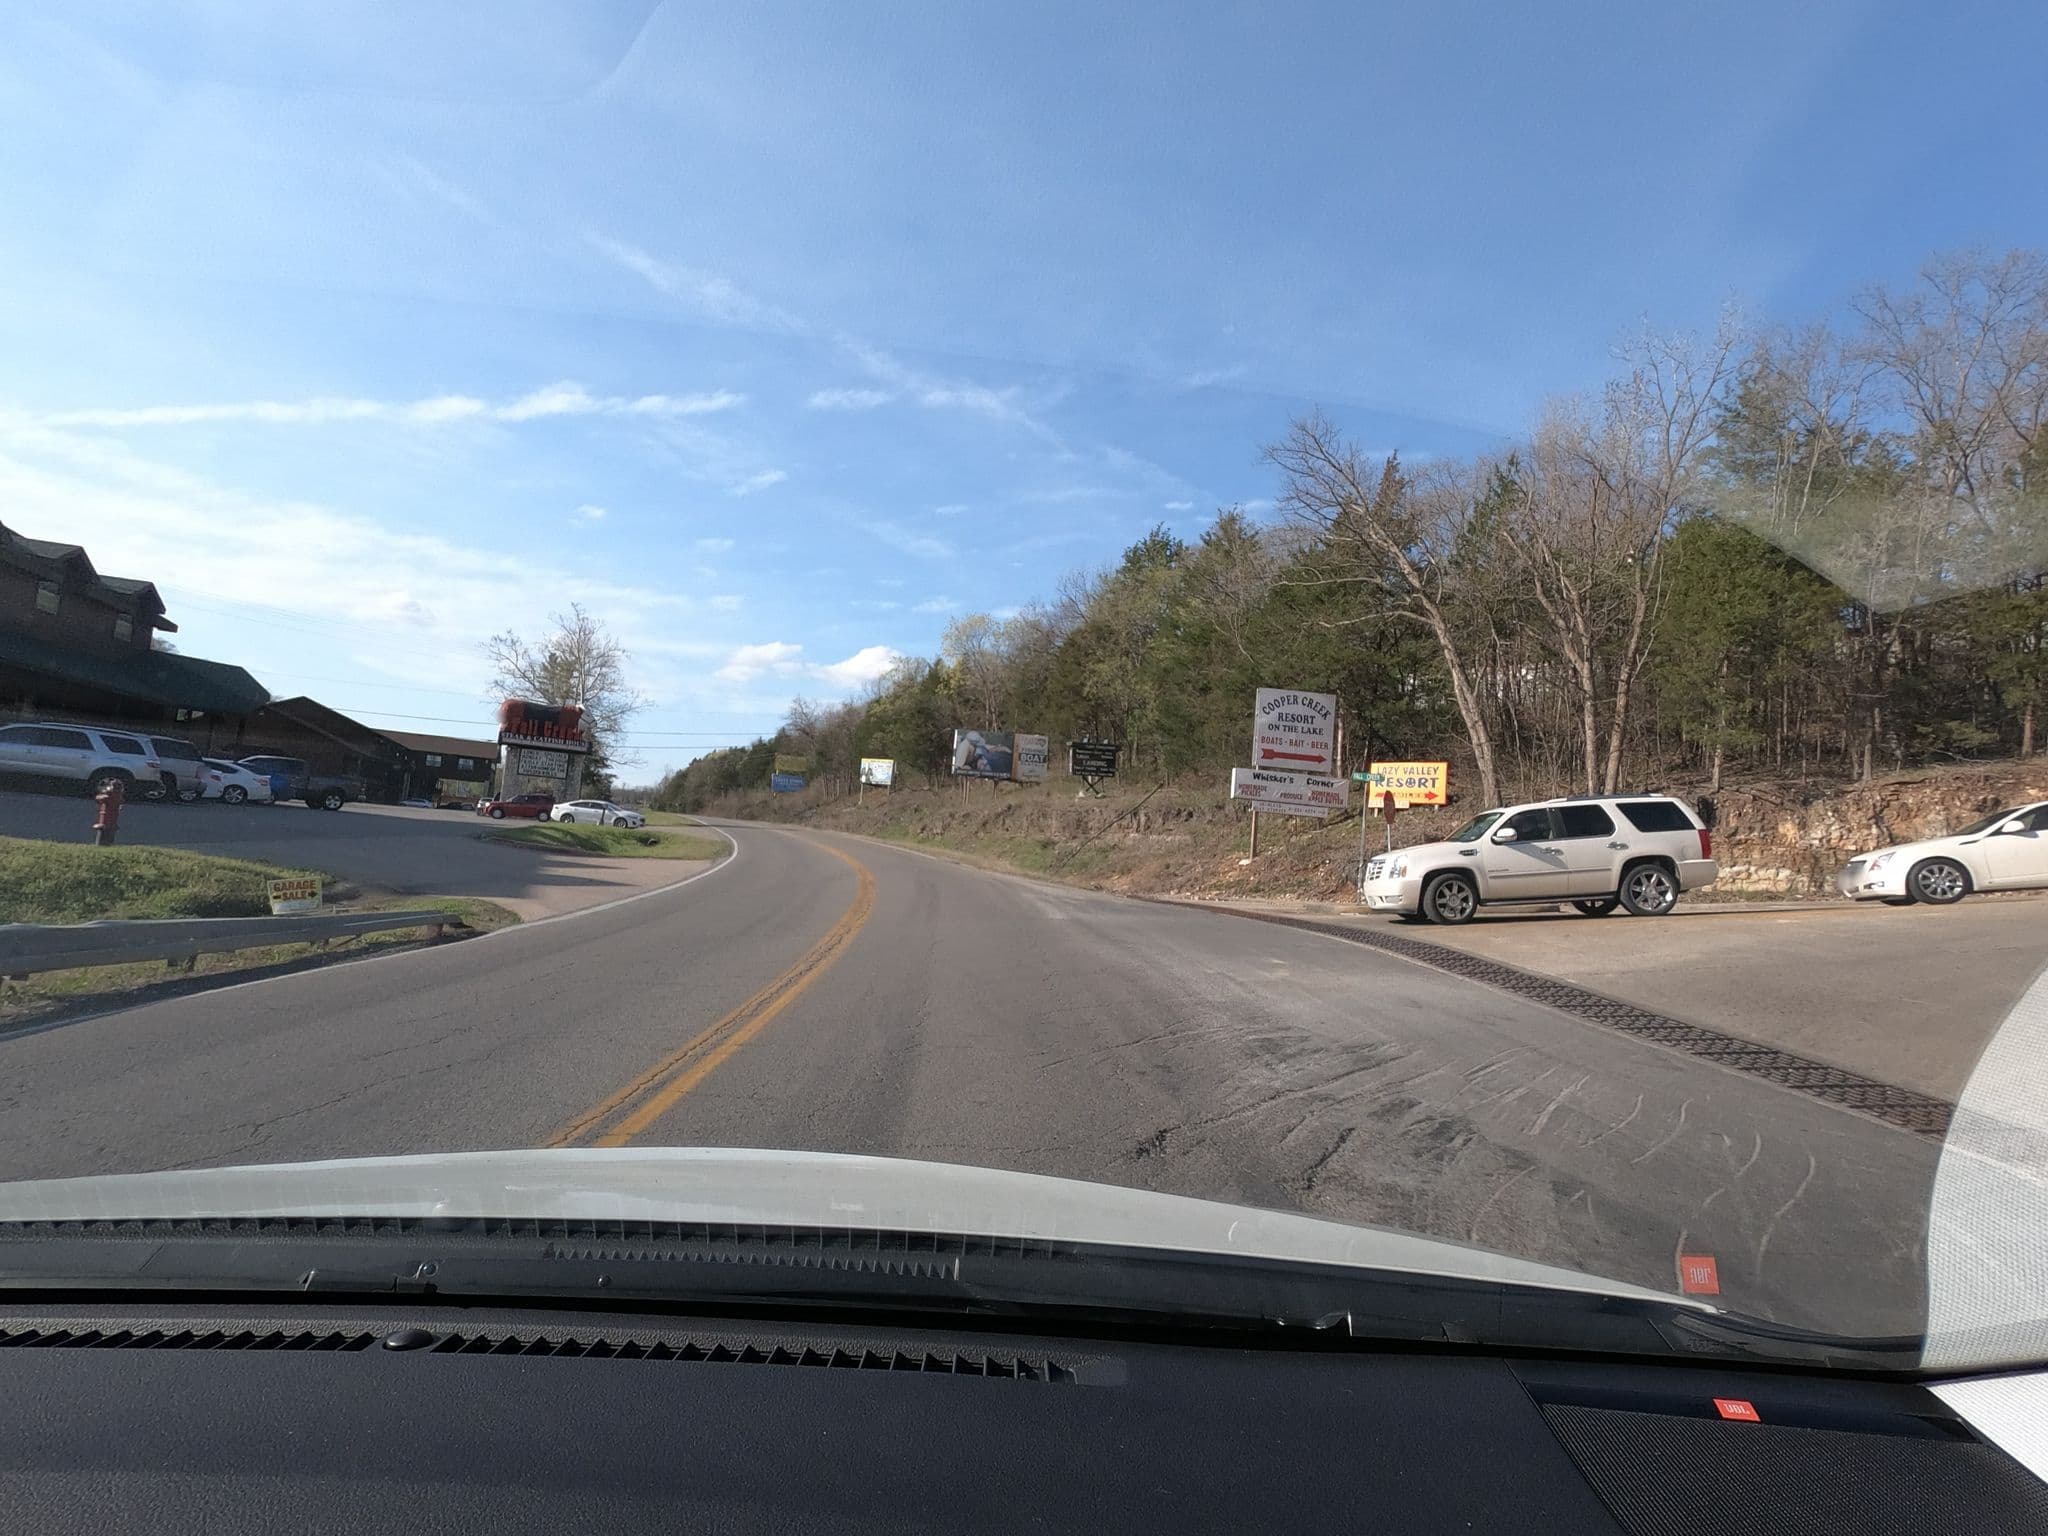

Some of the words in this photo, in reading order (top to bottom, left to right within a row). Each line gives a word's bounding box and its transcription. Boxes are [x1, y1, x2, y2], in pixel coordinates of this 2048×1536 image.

[1262, 694, 1299, 715] COOPER
[1301, 696, 1331, 720] CREEK
[1277, 712, 1316, 725] RESORT
[1268, 723, 1280, 732] ON
[1282, 725, 1299, 734] THE
[1301, 727, 1324, 736] LAKE
[1261, 736, 1283, 746] BOATS
[1289, 738, 1304, 748] BAIT
[1311, 741, 1329, 750] BEER
[1020, 753, 1045, 764] BOAT
[1377, 766, 1400, 775] LAZY
[1402, 766, 1439, 776] VALLEY
[1252, 772, 1295, 784] Whisker's
[1306, 777, 1335, 788] Corner
[1375, 777, 1439, 789] RESORT
[273, 880, 317, 892] GARAGE
[282, 891, 308, 901] SALE
